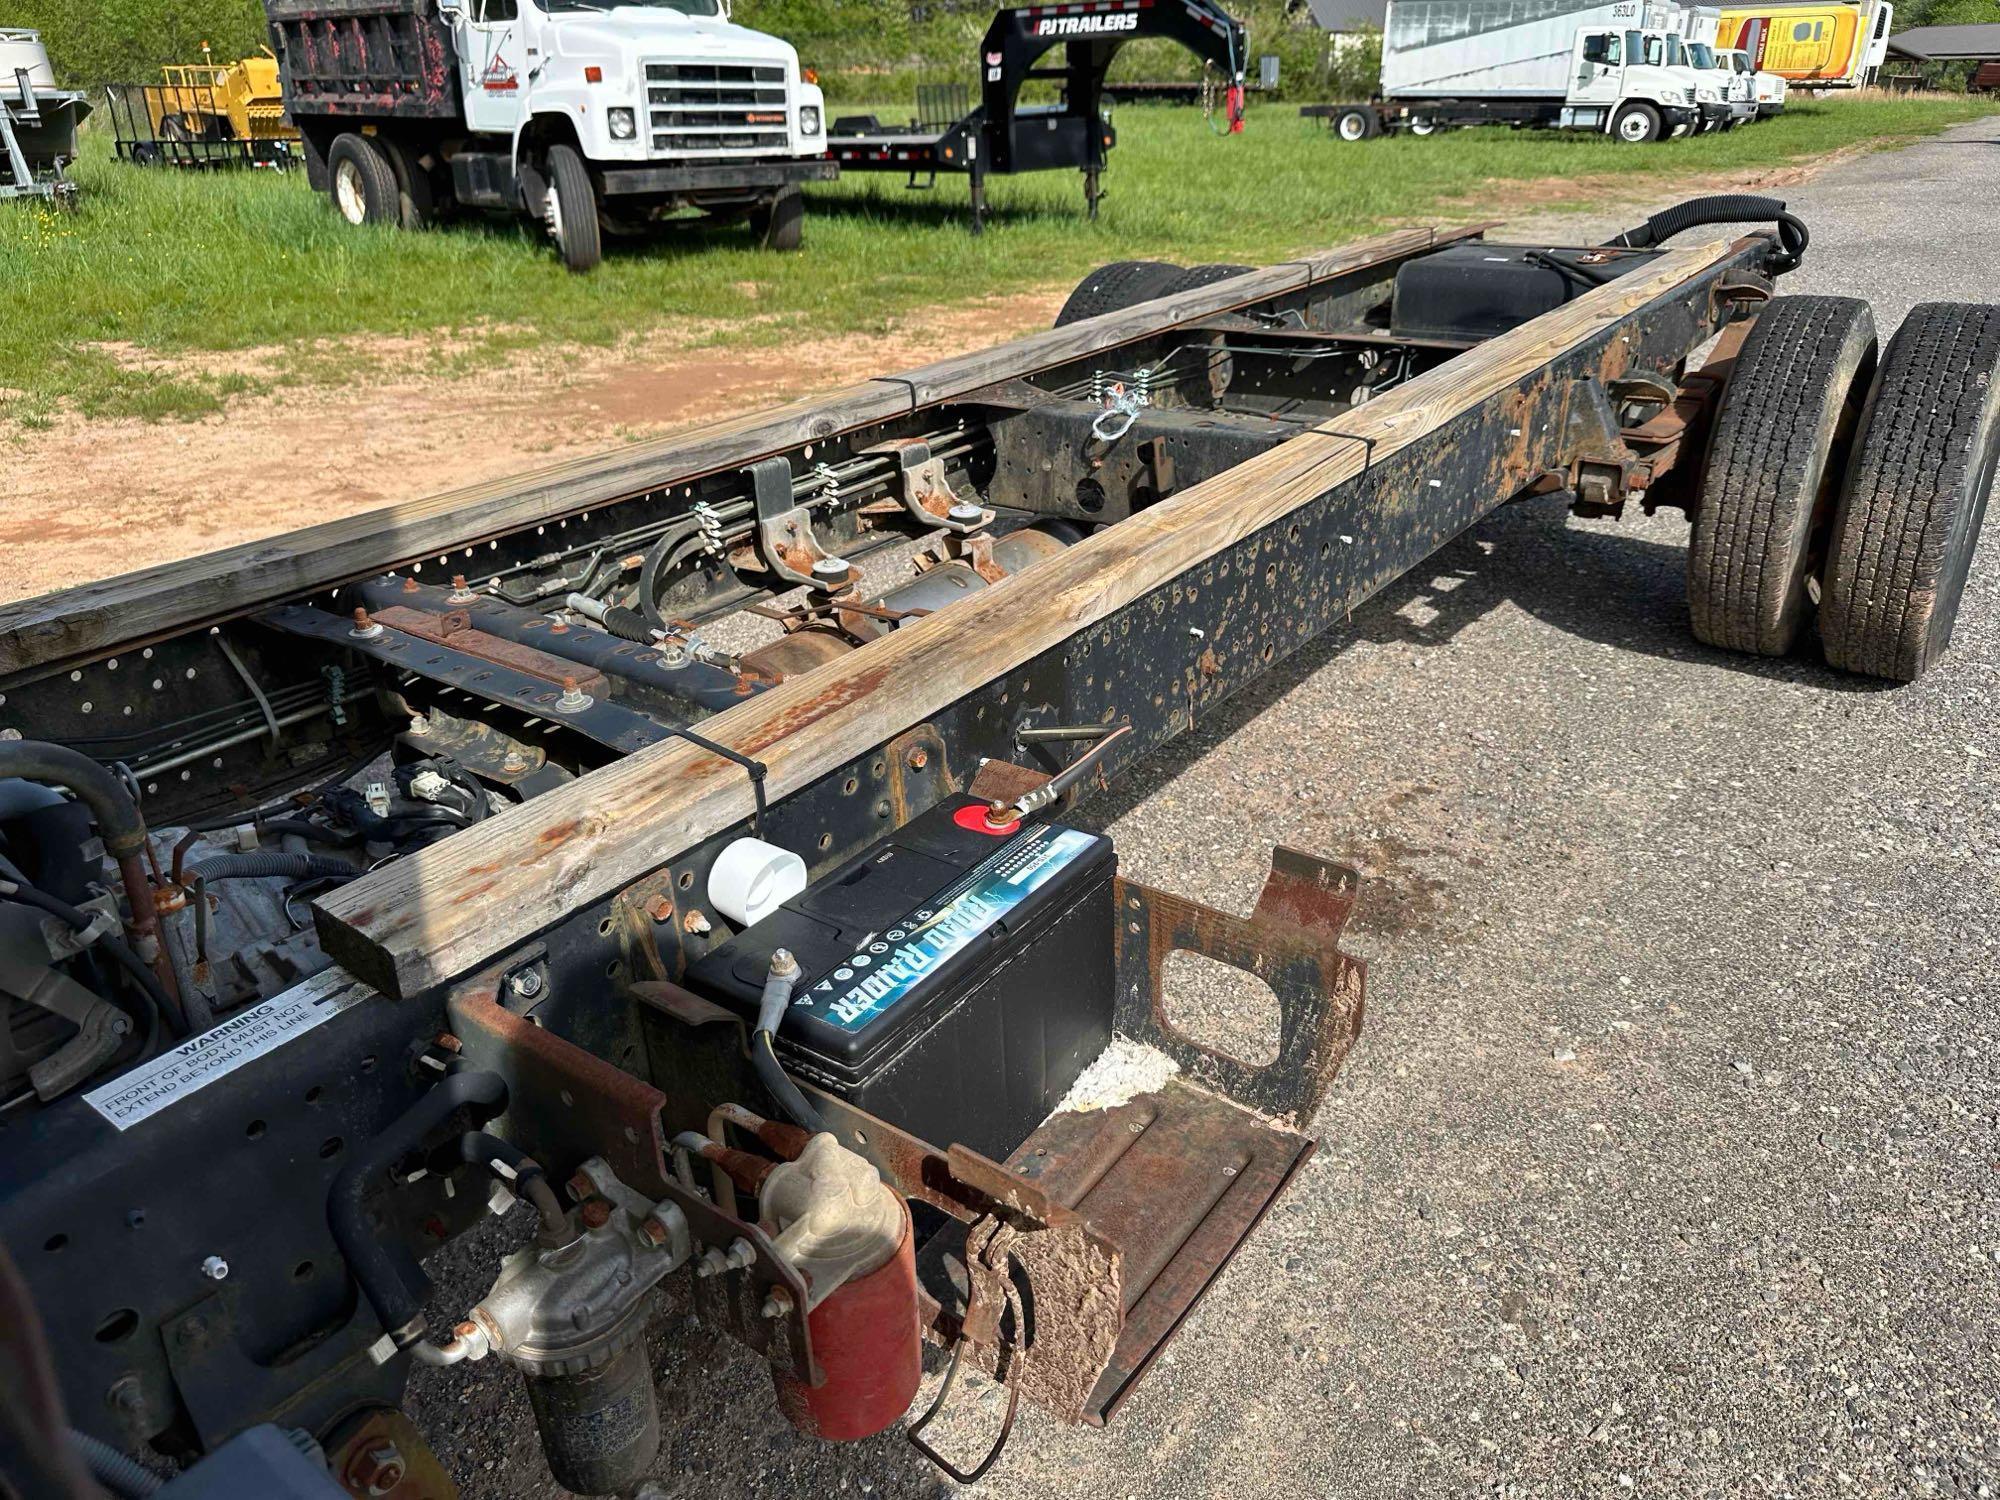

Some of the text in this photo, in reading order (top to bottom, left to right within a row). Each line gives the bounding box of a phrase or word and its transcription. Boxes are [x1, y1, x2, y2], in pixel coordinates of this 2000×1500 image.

[1039, 12, 1138, 36] PJ TRAILERS
[829, 894, 992, 1023] ROAD RAIDER
[105, 1004, 303, 1110] FRONT OF BODY MUST NOT
[115, 1012, 312, 1118] EXTEND BEYOND THIS LINE
[176, 1005, 275, 1056] WARNING
